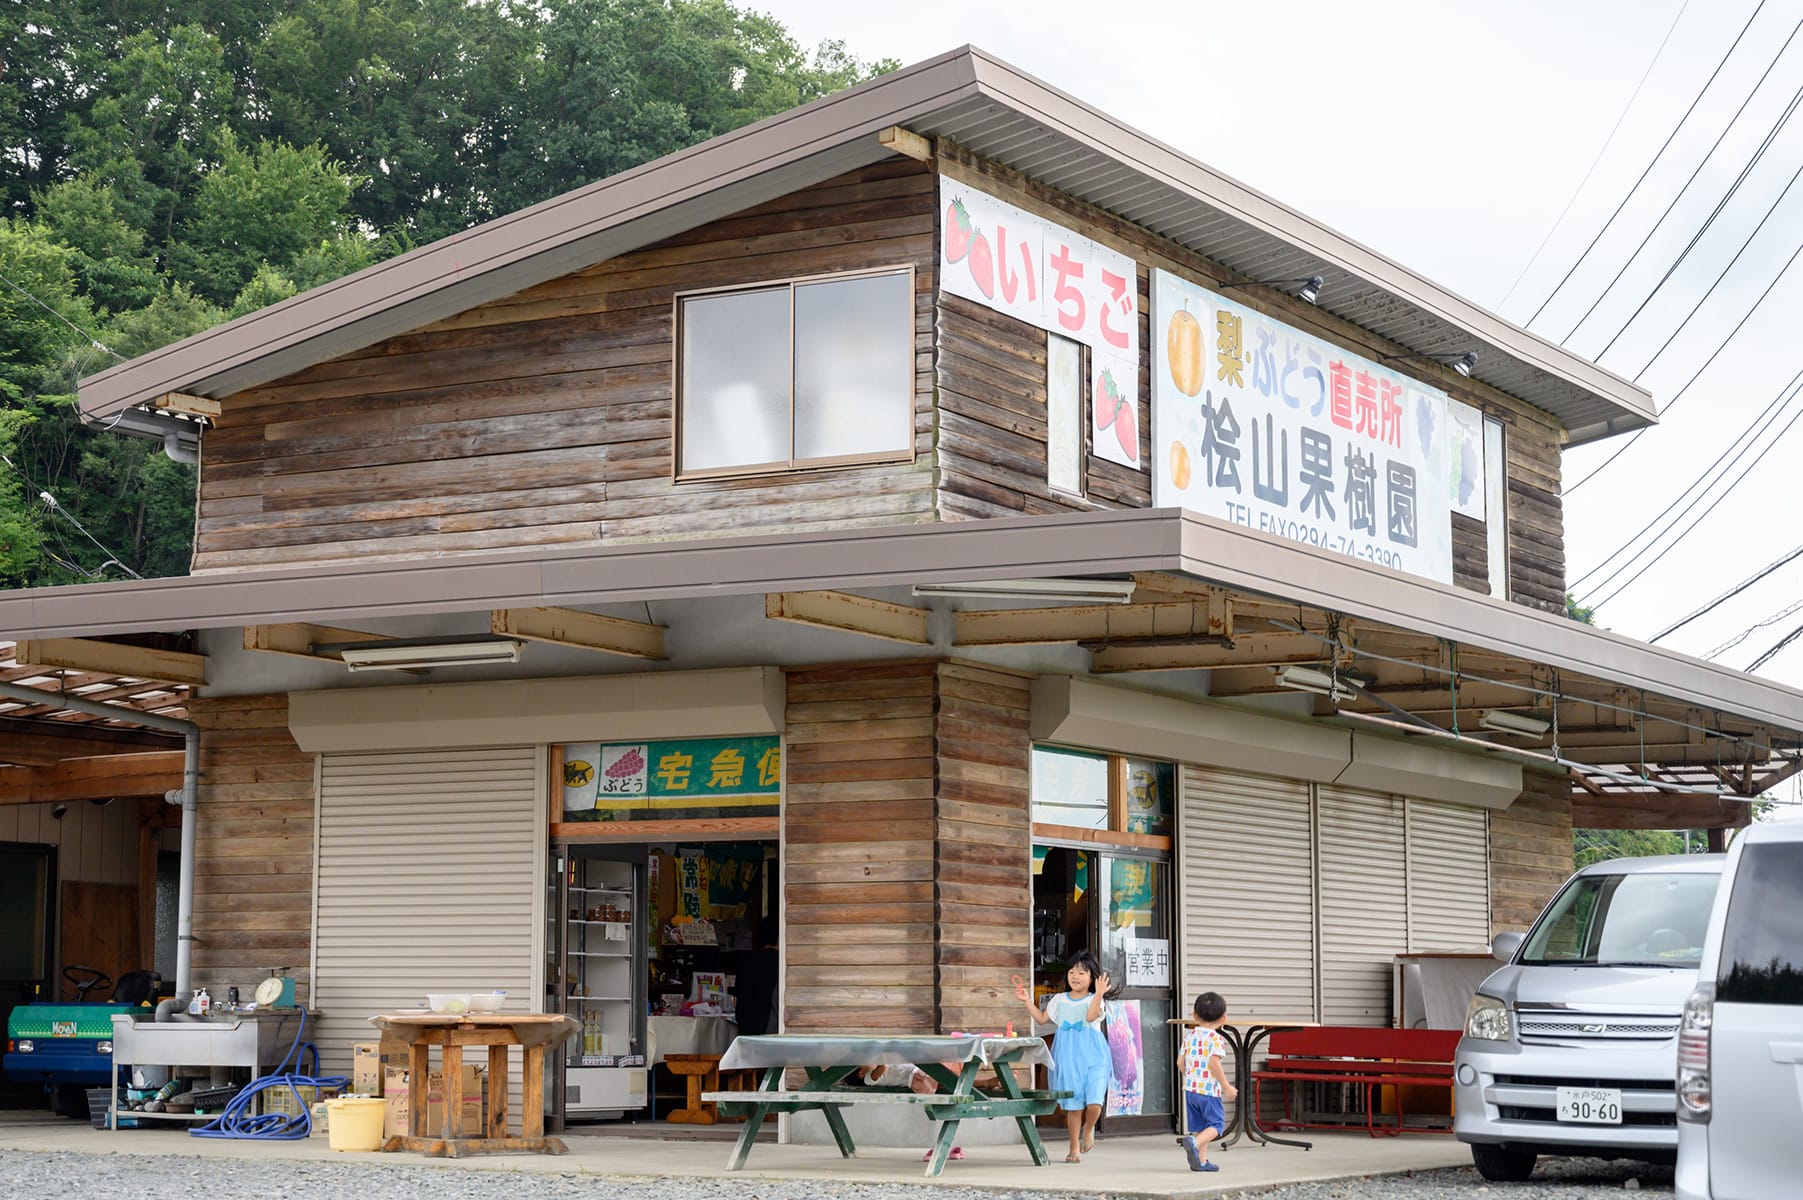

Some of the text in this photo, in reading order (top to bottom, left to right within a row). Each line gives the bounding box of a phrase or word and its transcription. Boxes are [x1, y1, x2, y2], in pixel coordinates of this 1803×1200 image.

[995, 226, 1133, 349] いちご
[1200, 389, 1418, 548] 桧山果樹園
[603, 777, 643, 793] ぶどう
[1128, 947, 1168, 976] 営業中
[1571, 1102, 1618, 1120] 90-60
